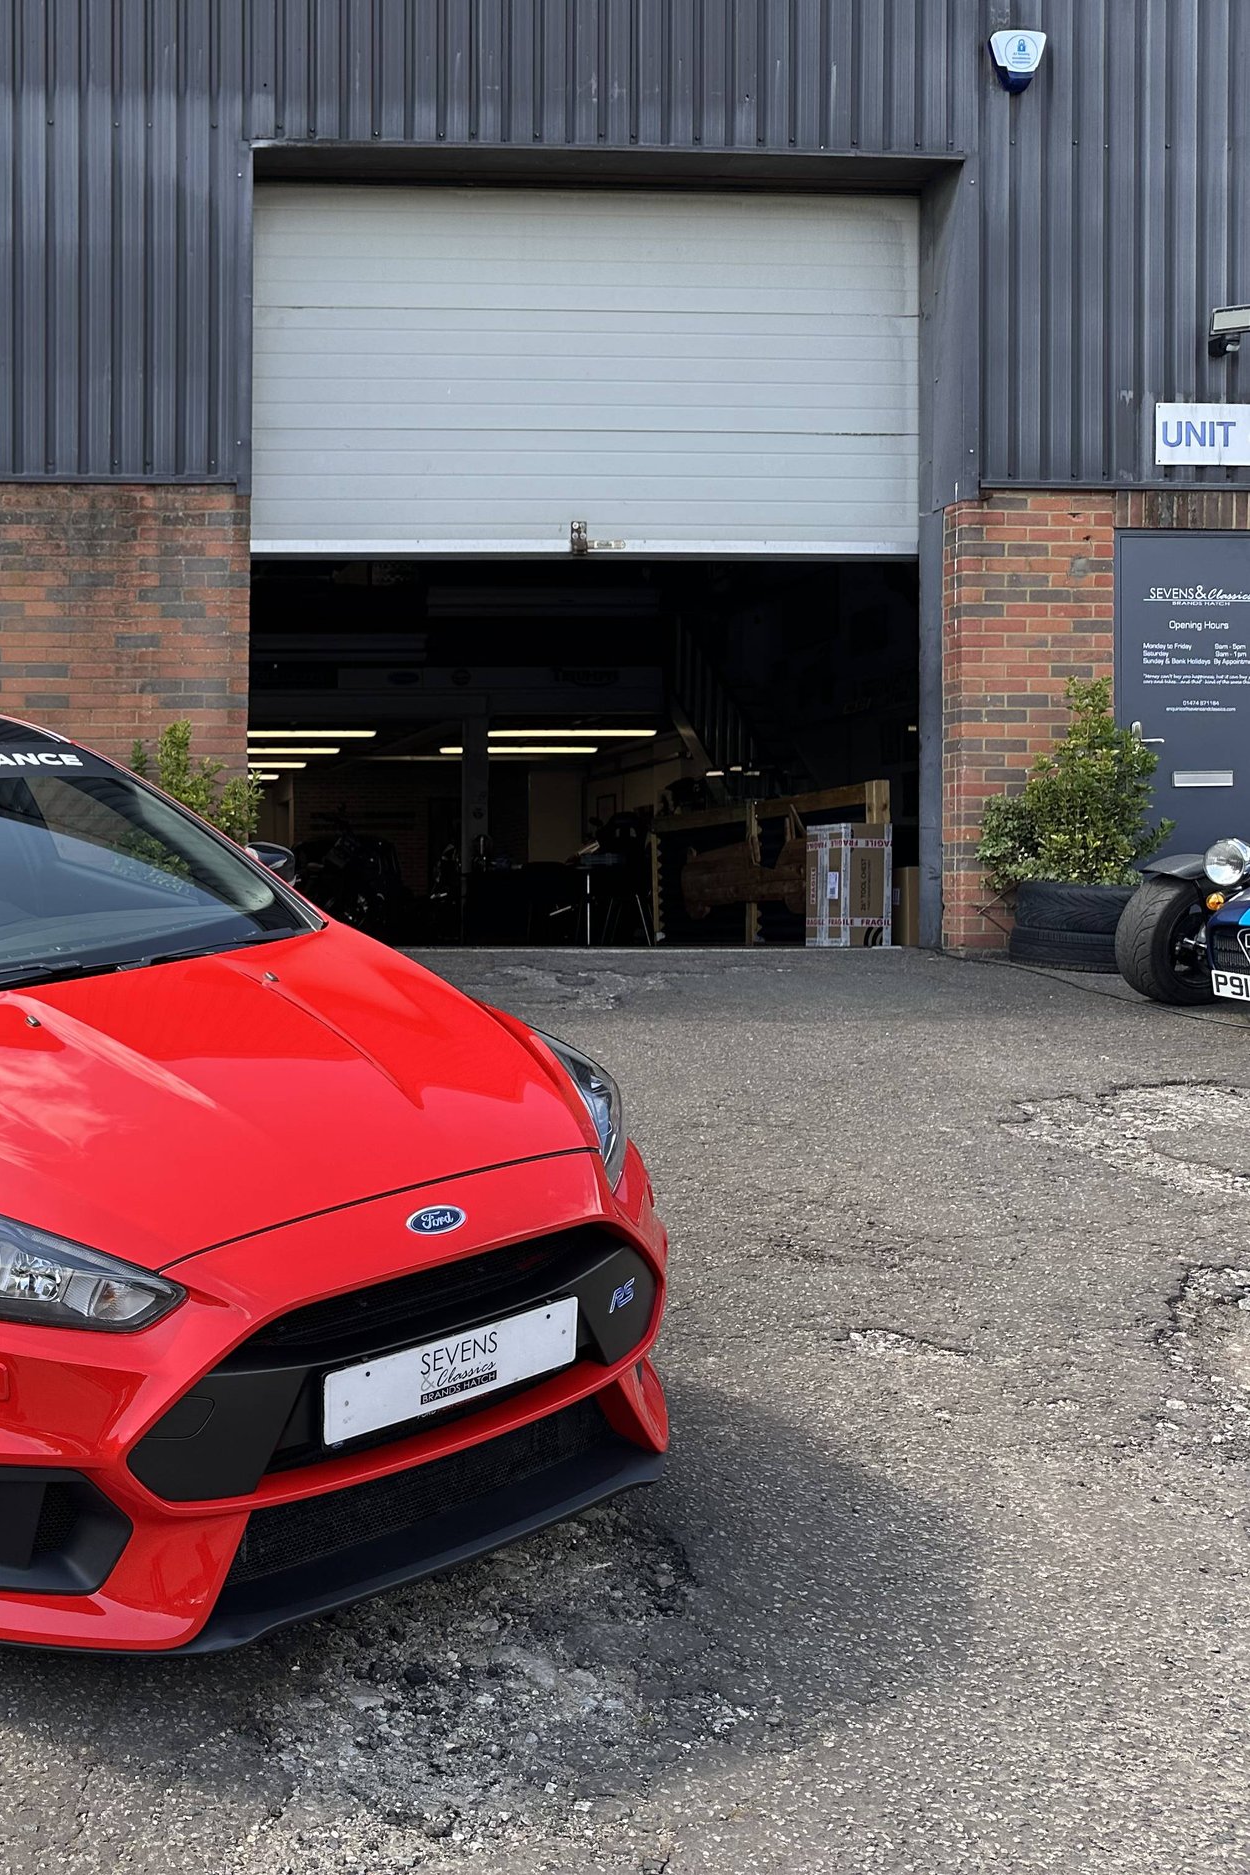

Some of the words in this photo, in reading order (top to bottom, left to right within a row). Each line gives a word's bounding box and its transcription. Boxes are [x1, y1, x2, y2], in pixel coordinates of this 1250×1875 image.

[1162, 421, 1237, 447] UNIT
[1150, 587, 1194, 599] SEVENS
[1195, 585, 1207, 599] &
[1169, 620, 1202, 631] Opening
[1204, 620, 1229, 630] Hours
[1143, 650, 1169, 658] Saturday
[1174, 643, 1192, 651] Friday
[1143, 658, 1164, 666] Sunday
[1187, 658, 1211, 666] Holidays
[420, 1210, 454, 1230] Ford
[609, 1277, 635, 1314] RS
[420, 1331, 498, 1375] SEVENS
[420, 1372, 436, 1392] &
[436, 1360, 497, 1387] Classics
[421, 1384, 461, 1404] BRANDS
[463, 1371, 496, 1390] HATCH
